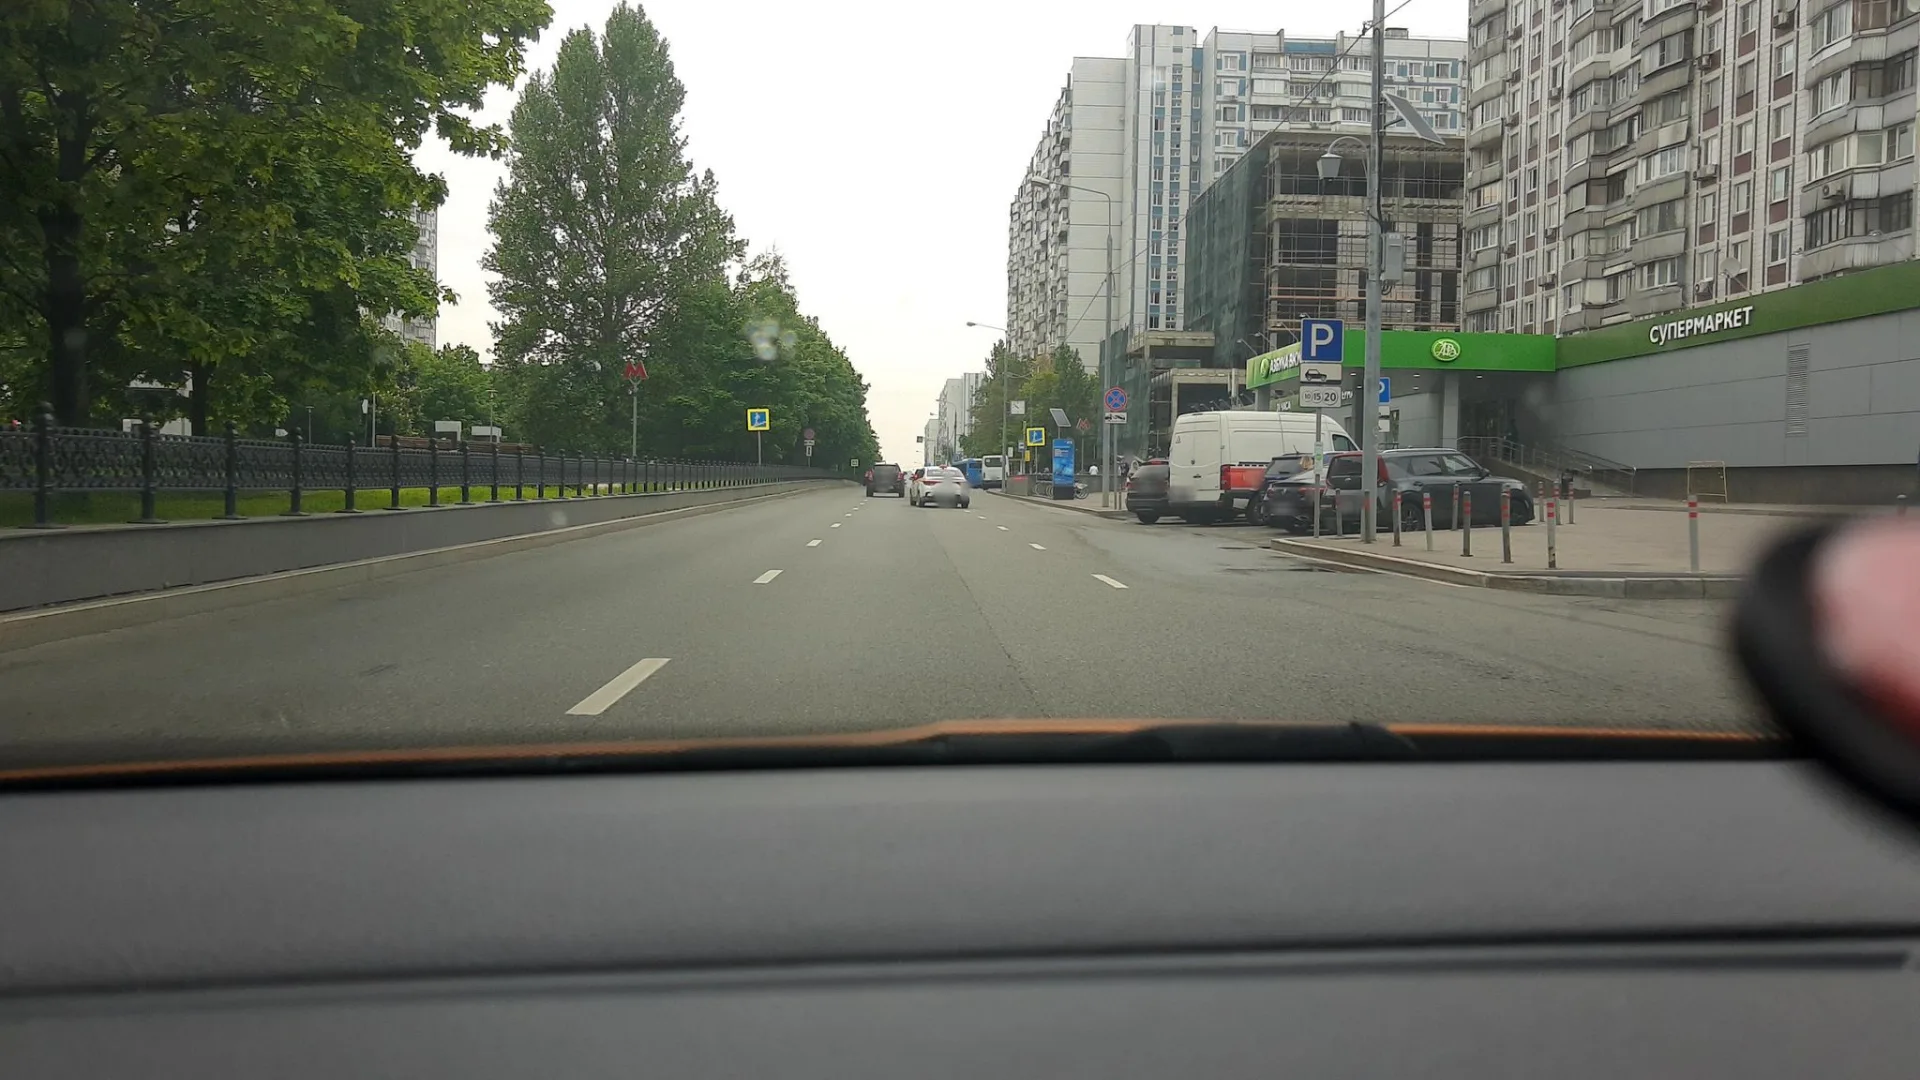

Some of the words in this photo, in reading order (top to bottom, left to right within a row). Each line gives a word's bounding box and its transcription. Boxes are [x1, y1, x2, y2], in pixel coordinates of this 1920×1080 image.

[1649, 306, 1753, 345] СУПЕРМАРКЕТ
[1310, 323, 1334, 357] P
[622, 359, 649, 380] М
[1313, 393, 1321, 401] 15
[1324, 392, 1337, 402] 20
